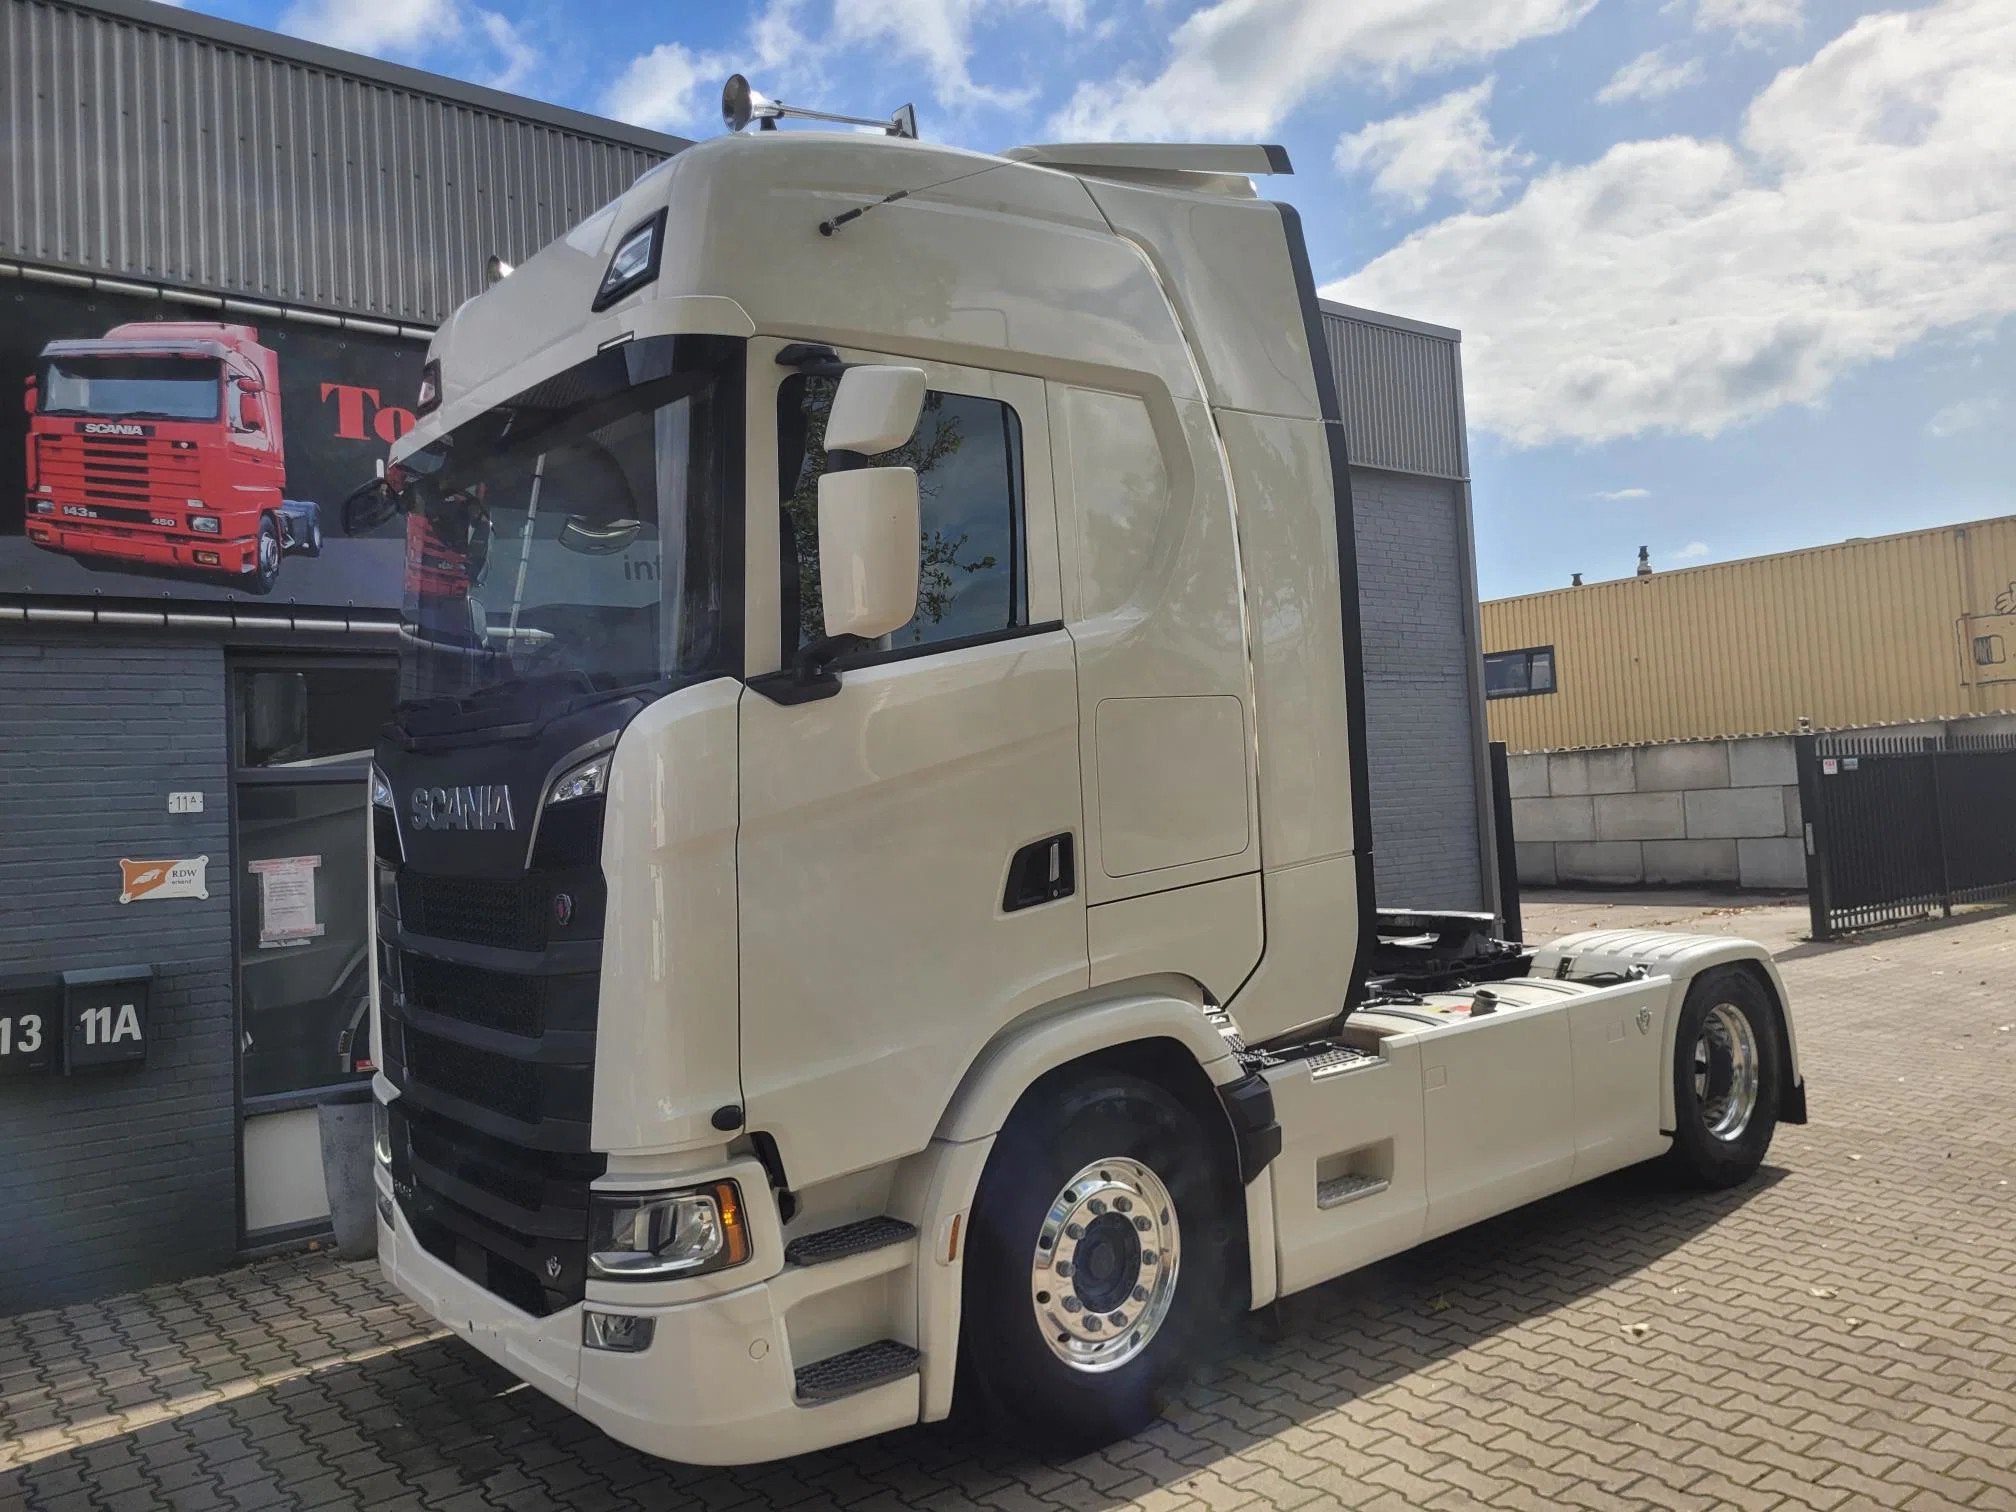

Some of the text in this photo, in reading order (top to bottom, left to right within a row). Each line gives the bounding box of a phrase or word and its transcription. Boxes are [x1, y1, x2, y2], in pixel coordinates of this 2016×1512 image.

[85, 423, 143, 436] SCANIA
[321, 383, 416, 444] To
[152, 518, 175, 527] 450
[411, 785, 516, 831] SCANIA
[172, 869, 198, 878] RDW
[0, 1014, 42, 1055] 13
[80, 1004, 142, 1045] 11A
